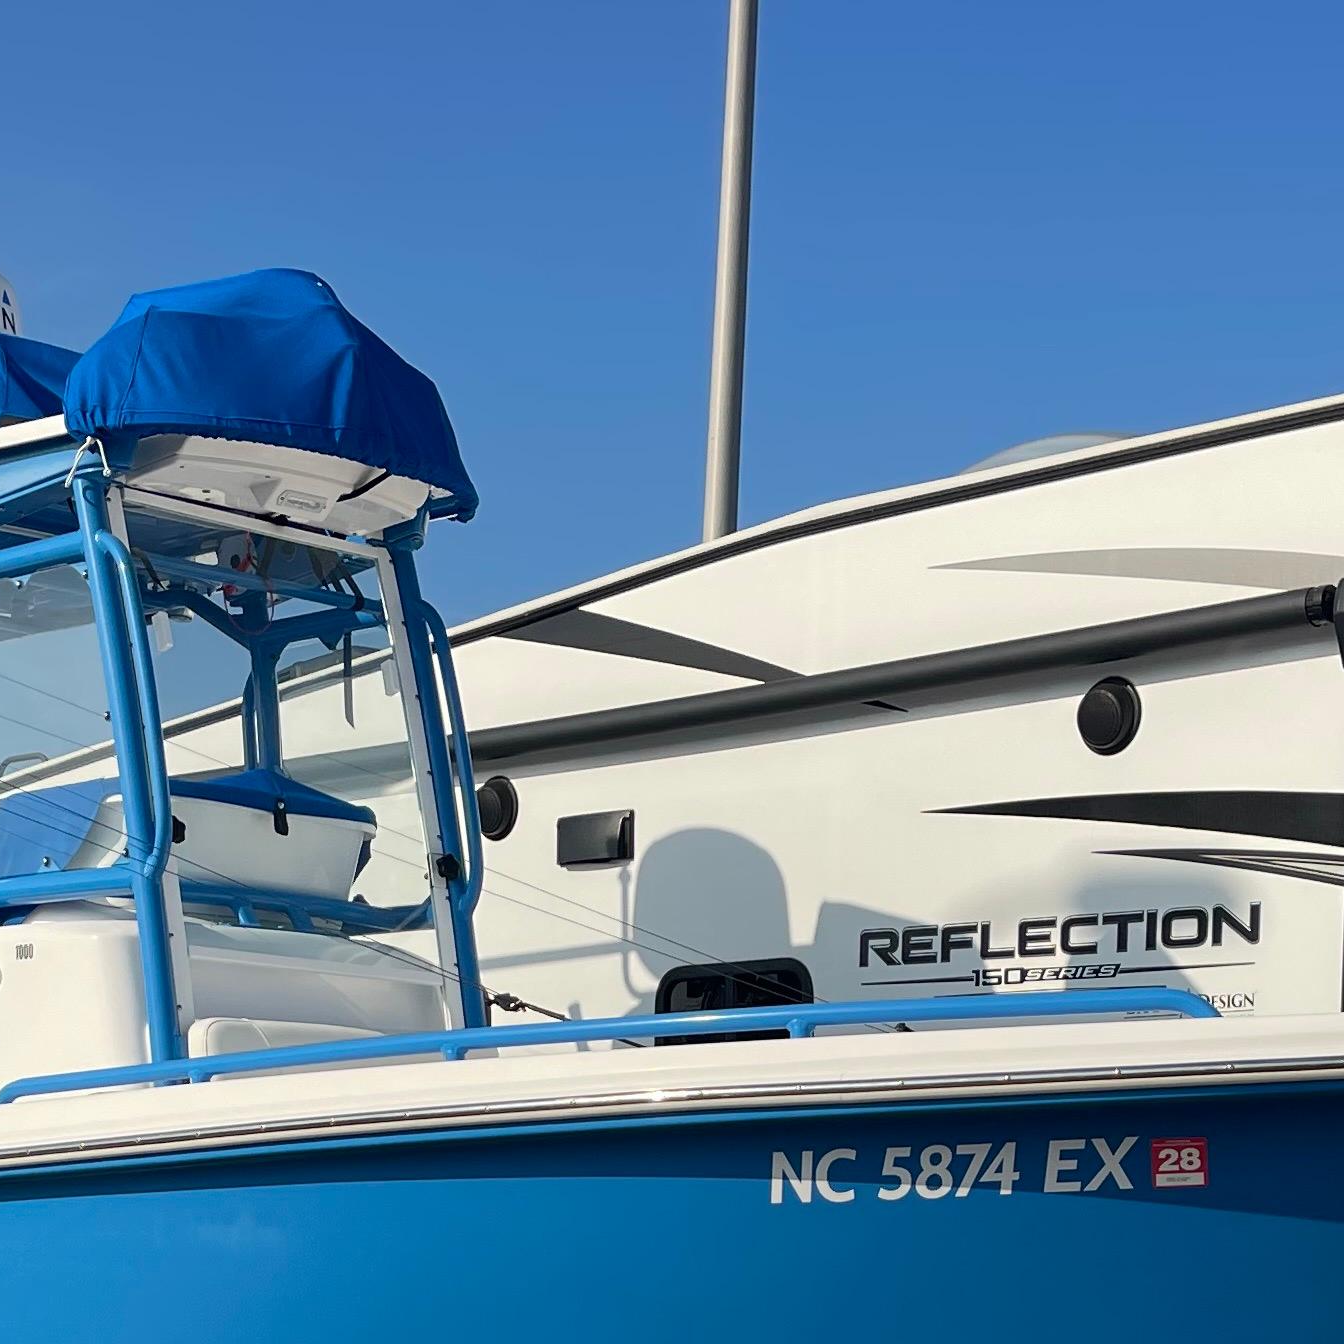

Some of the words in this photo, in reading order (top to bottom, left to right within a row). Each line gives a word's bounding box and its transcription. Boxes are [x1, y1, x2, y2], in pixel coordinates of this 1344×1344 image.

[859, 901, 1262, 968] REFLECTION
[971, 966, 1025, 987] 150
[1023, 964, 1117, 981] SERIES
[770, 1148, 856, 1204] NC
[877, 1141, 1019, 1201] 5874
[1043, 1136, 1138, 1193] EX
[1158, 1147, 1202, 1172] 28
